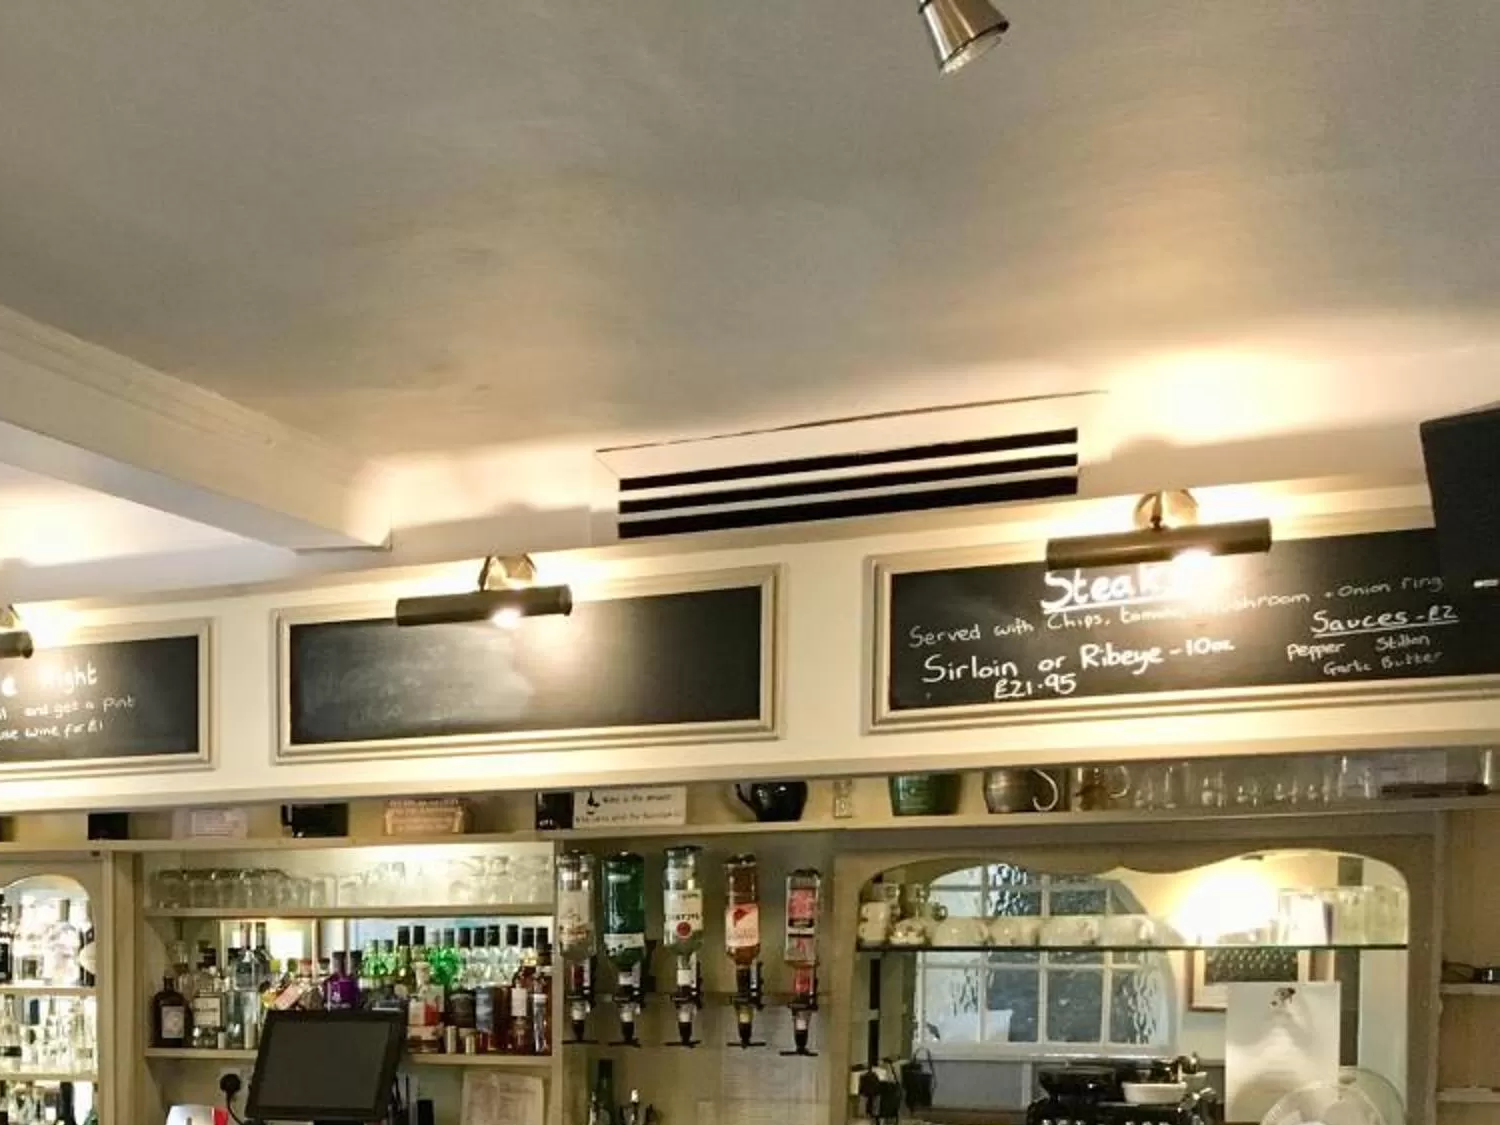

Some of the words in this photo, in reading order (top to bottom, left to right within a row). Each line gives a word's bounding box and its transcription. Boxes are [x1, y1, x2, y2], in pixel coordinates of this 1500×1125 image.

[909, 625, 981, 648] Served
[993, 618, 1034, 638] with
[1310, 609, 1409, 634] Sauces
[39, 660, 98, 695] ight
[922, 654, 1018, 683] Sirloin
[1036, 655, 1067, 673] or
[1080, 641, 1165, 676] Ribeye
